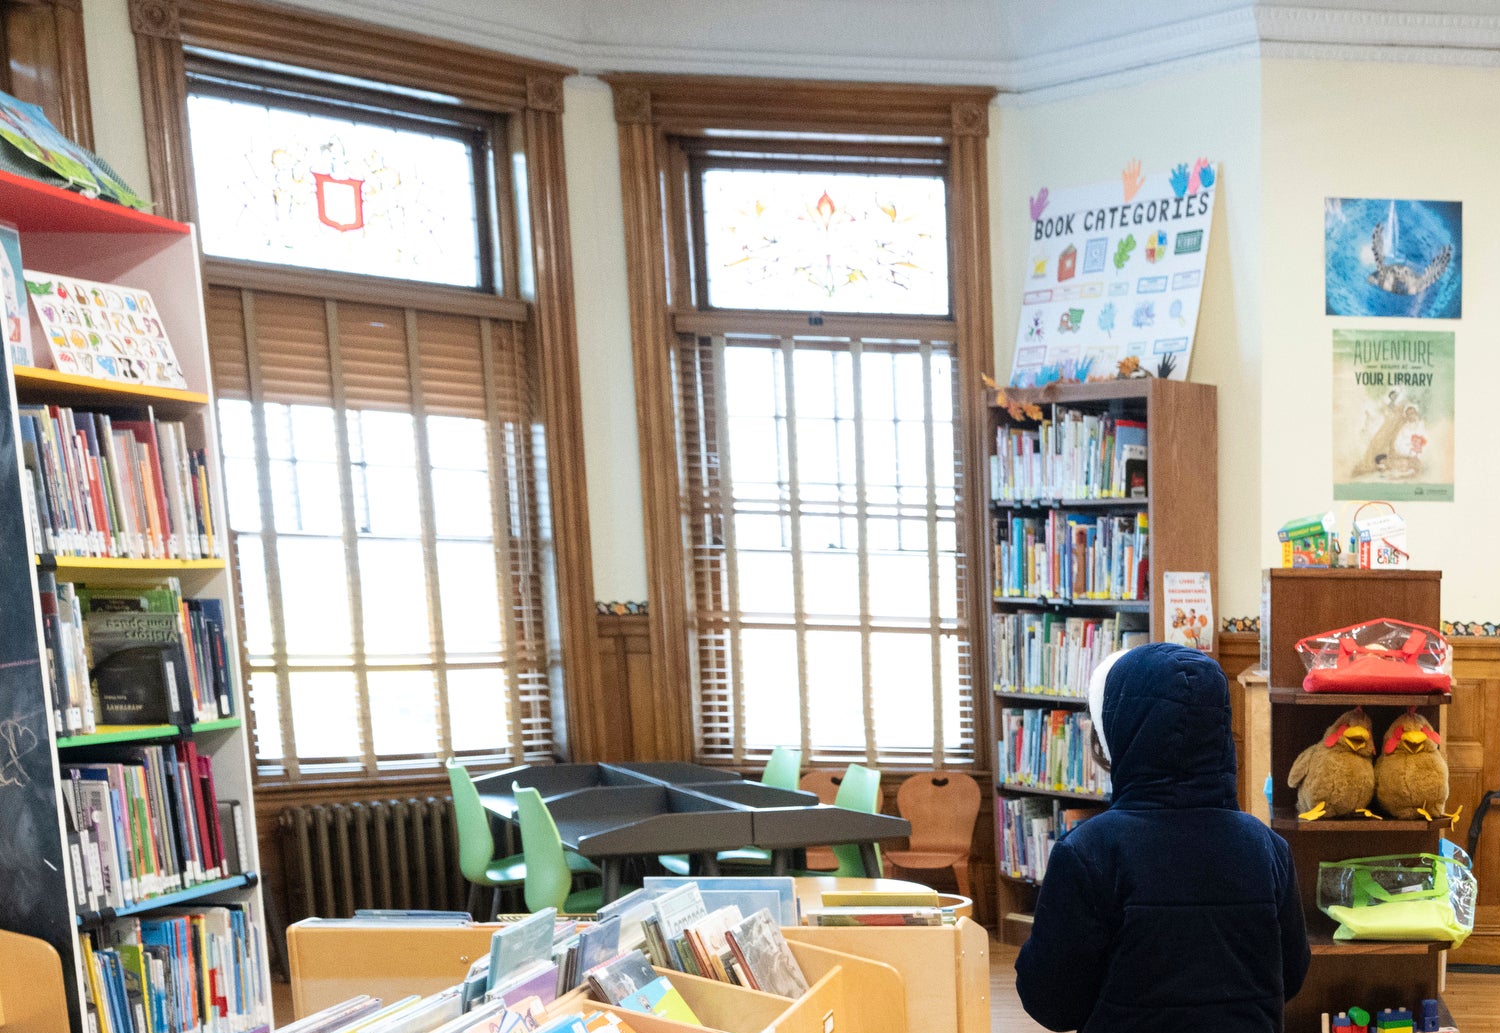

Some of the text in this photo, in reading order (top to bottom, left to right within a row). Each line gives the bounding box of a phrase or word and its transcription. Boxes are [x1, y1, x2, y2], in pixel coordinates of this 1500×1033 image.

[1034, 192, 1210, 241] BOOK CATEGORIES
[1353, 339, 1435, 369] ADVENTURE
[1355, 372, 1433, 387] YOUR LIBRARY
